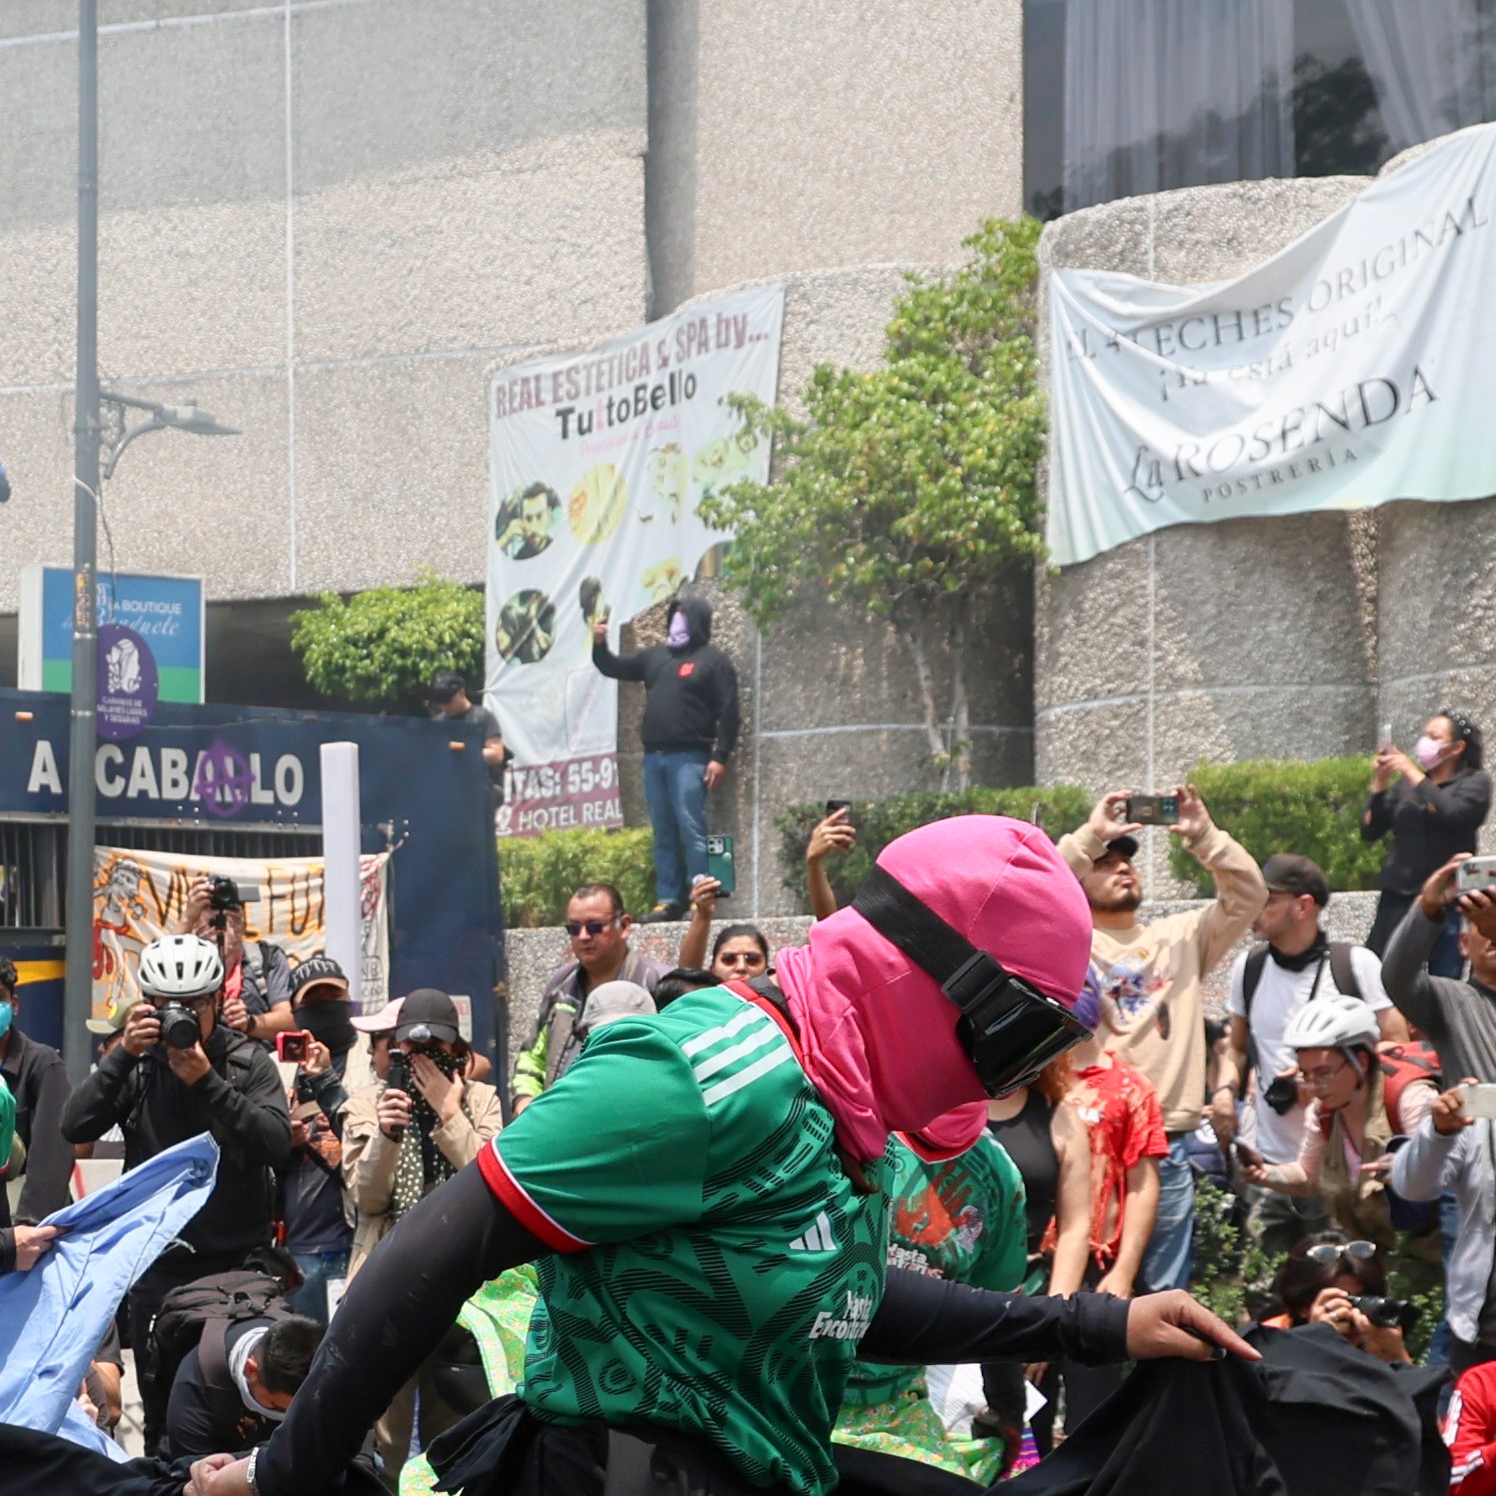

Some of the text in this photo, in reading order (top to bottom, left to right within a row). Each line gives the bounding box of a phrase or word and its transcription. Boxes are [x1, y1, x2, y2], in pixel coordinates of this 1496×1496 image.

[1308, 196, 1490, 312] ORIGINAL
[495, 373, 546, 419] REAL
[675, 316, 710, 363] SPA
[1173, 363, 1440, 482] ROSENDA
[121, 600, 183, 615] BOUTIQUE
[26, 739, 63, 795] A
[503, 765, 562, 805] ITAS:
[518, 798, 624, 831] HOTEL REAL
